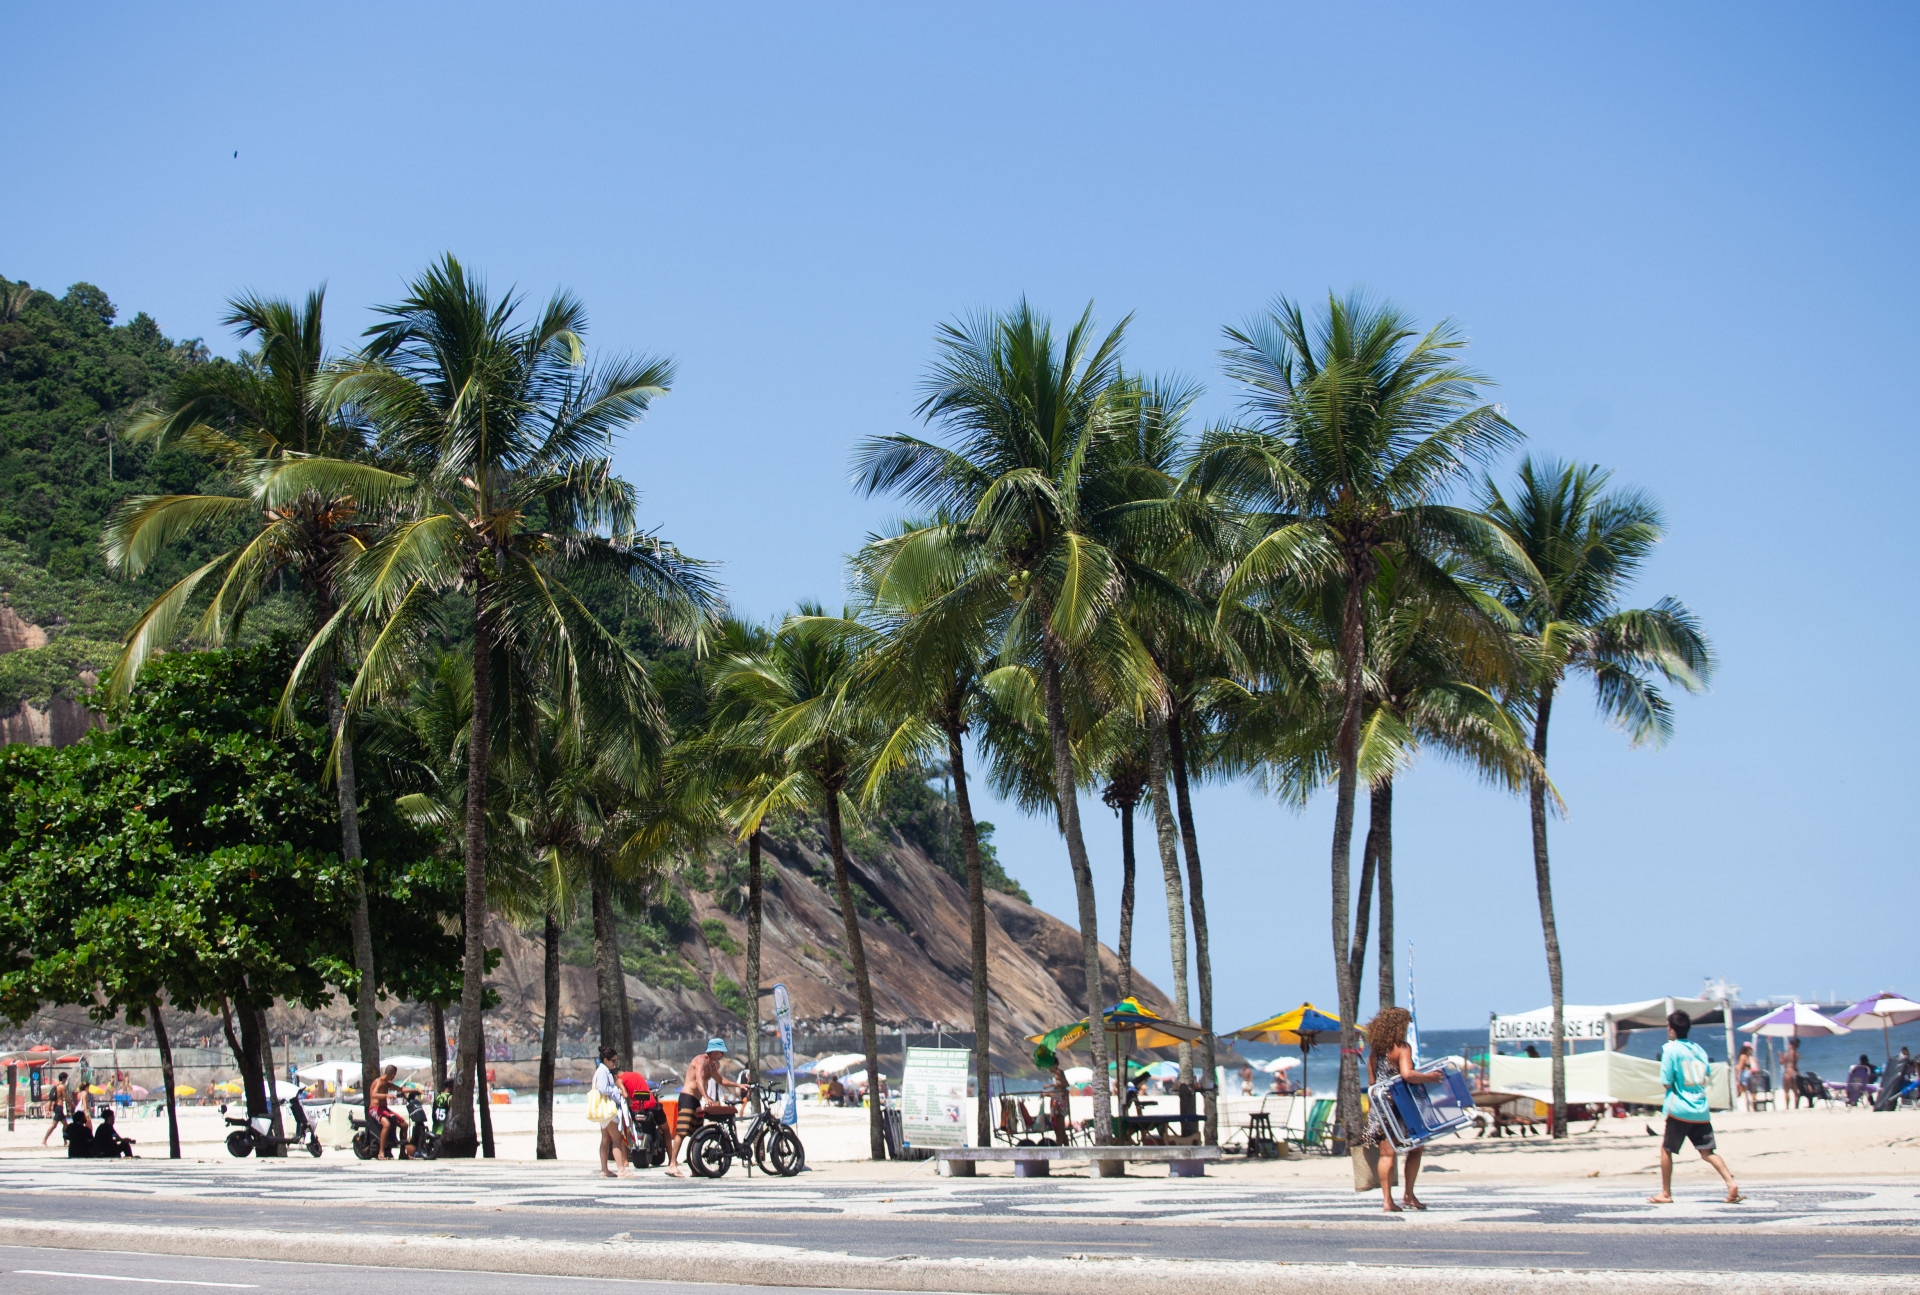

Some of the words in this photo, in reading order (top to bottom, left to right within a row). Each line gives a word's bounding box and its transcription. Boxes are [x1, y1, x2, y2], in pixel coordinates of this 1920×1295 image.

[1525, 1020, 1583, 1038] PARAISE
[1681, 1060, 1705, 1086] 10
[435, 1107, 446, 1121] 15
